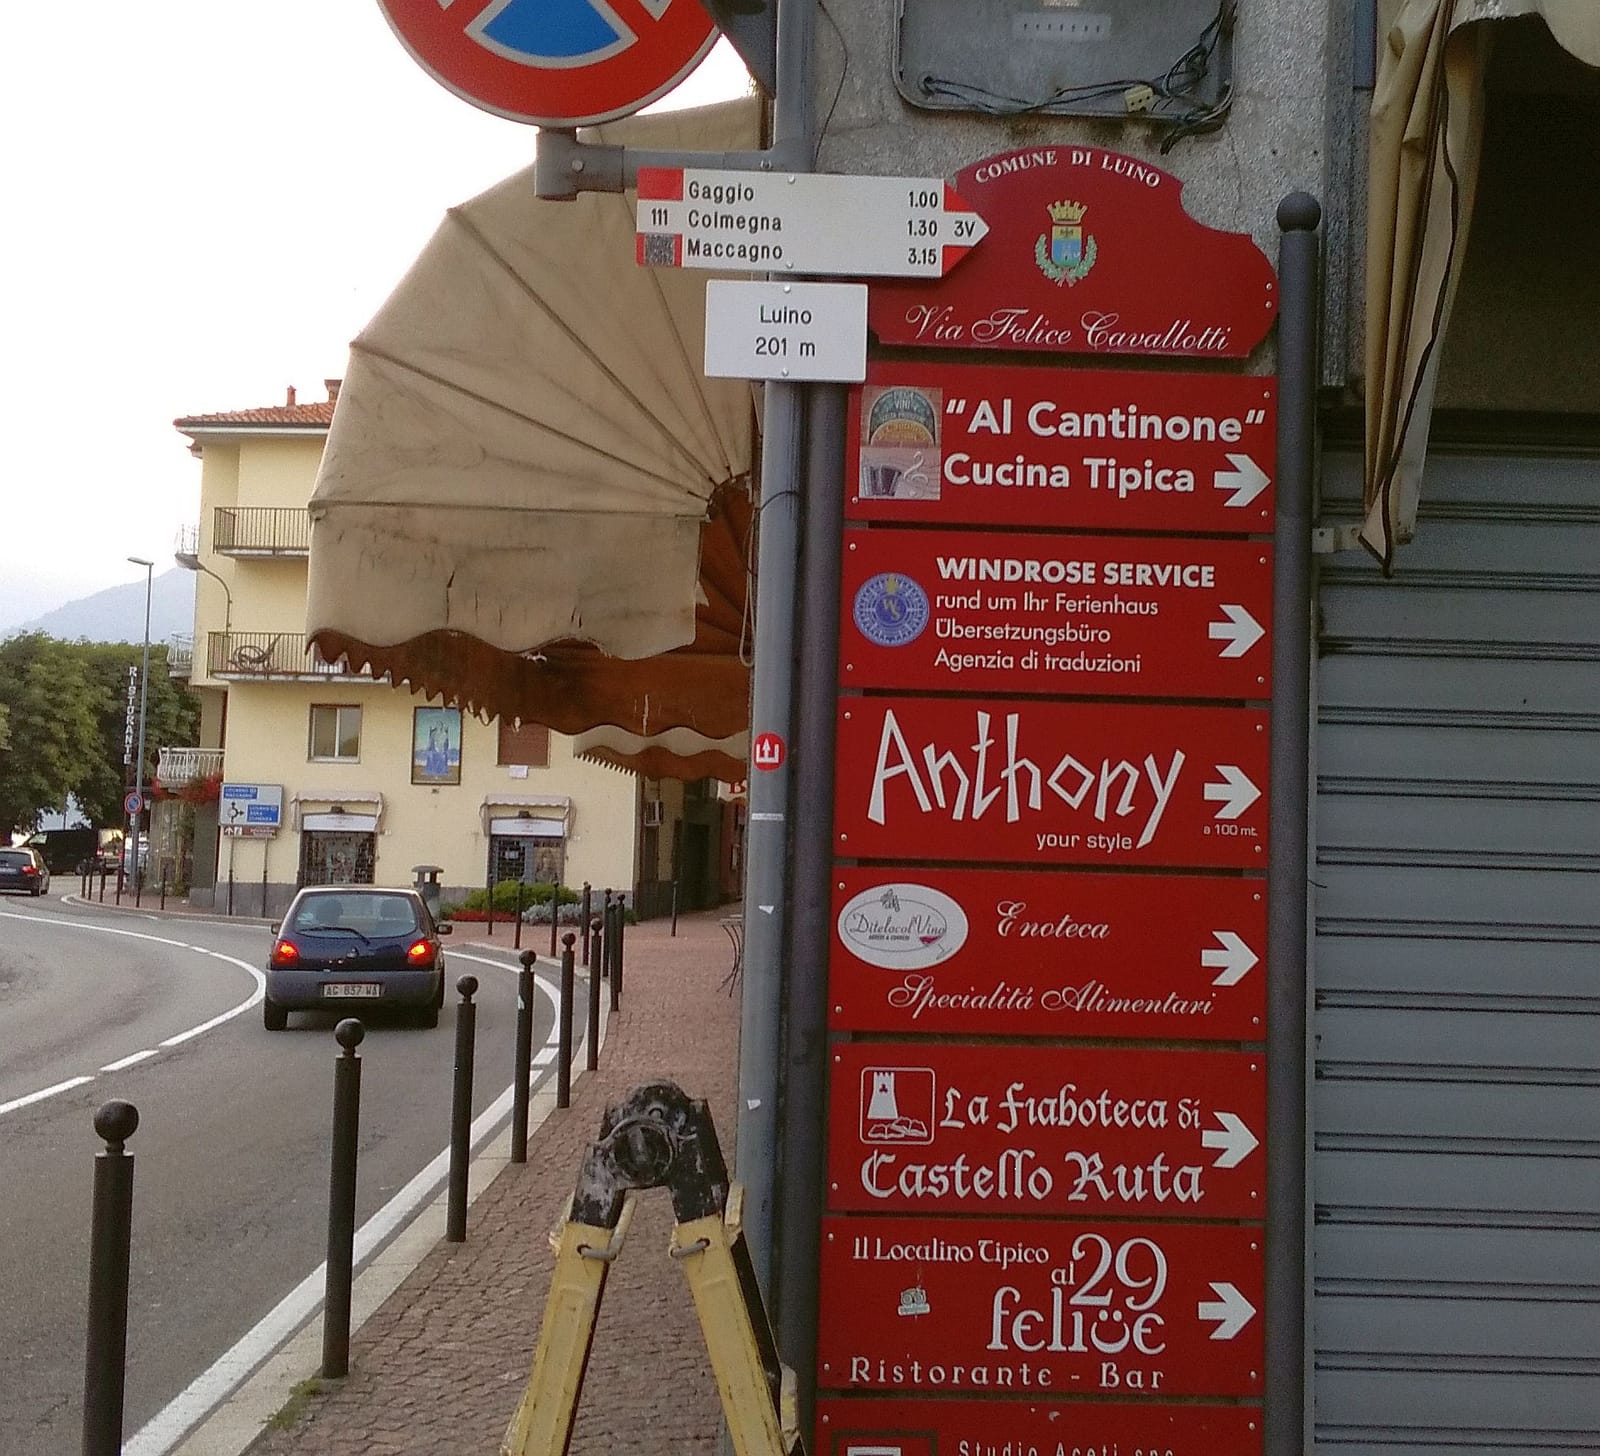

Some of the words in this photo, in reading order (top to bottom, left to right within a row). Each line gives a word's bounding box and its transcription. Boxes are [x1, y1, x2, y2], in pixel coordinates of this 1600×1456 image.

[974, 150, 1058, 184] COMUNE
[1071, 150, 1092, 166] DI
[1101, 154, 1162, 188] LUINO
[688, 181, 755, 205] Gaggio
[908, 191, 939, 209] 1.00
[651, 209, 669, 226] 111
[688, 210, 782, 234] Colmegna
[907, 220, 939, 237] 1.30
[954, 222, 976, 238] 3V
[687, 240, 784, 263] Maccagno
[907, 248, 938, 266] 3.15
[759, 305, 813, 325] Luino
[905, 304, 964, 341] Via
[970, 308, 1072, 346] Felice
[1080, 310, 1232, 351] Cavallotti
[755, 337, 788, 357] 201
[799, 342, 816, 358] m
[943, 453, 1070, 489] Cucina
[1082, 456, 1195, 499] Tipica
[936, 556, 1097, 585] WINDROSE
[1102, 561, 1216, 588] SERVICE
[935, 589, 981, 610] rund
[987, 594, 1018, 611] um
[1023, 590, 1049, 612] Ihr
[1055, 592, 1159, 616] Ferienhaus
[935, 617, 1112, 646] Übersetzungsbüro
[933, 647, 1015, 674] Agenzia
[1020, 648, 1039, 670] di
[1044, 650, 1142, 674] traduzioni
[123, 666, 138, 765] RISTORANTE
[867, 708, 1187, 850] Anthony
[1036, 832, 1081, 852] your
[1086, 831, 1133, 854] style
[1214, 823, 1239, 837] 100
[997, 900, 1110, 940] Enoteca
[1040, 979, 1218, 1016] Alimentari
[939, 1086, 990, 1130] La
[1176, 1098, 1202, 1130] di
[860, 1147, 1054, 1201] Castello
[1064, 1150, 1205, 1203] Ruta
[873, 1237, 974, 1263] Localino
[977, 1239, 1050, 1271] Tipico
[1050, 1260, 1076, 1286] al
[1069, 1232, 1169, 1311] 29
[850, 1356, 1052, 1385] Ristorante
[1099, 1361, 1165, 1390] Bar
